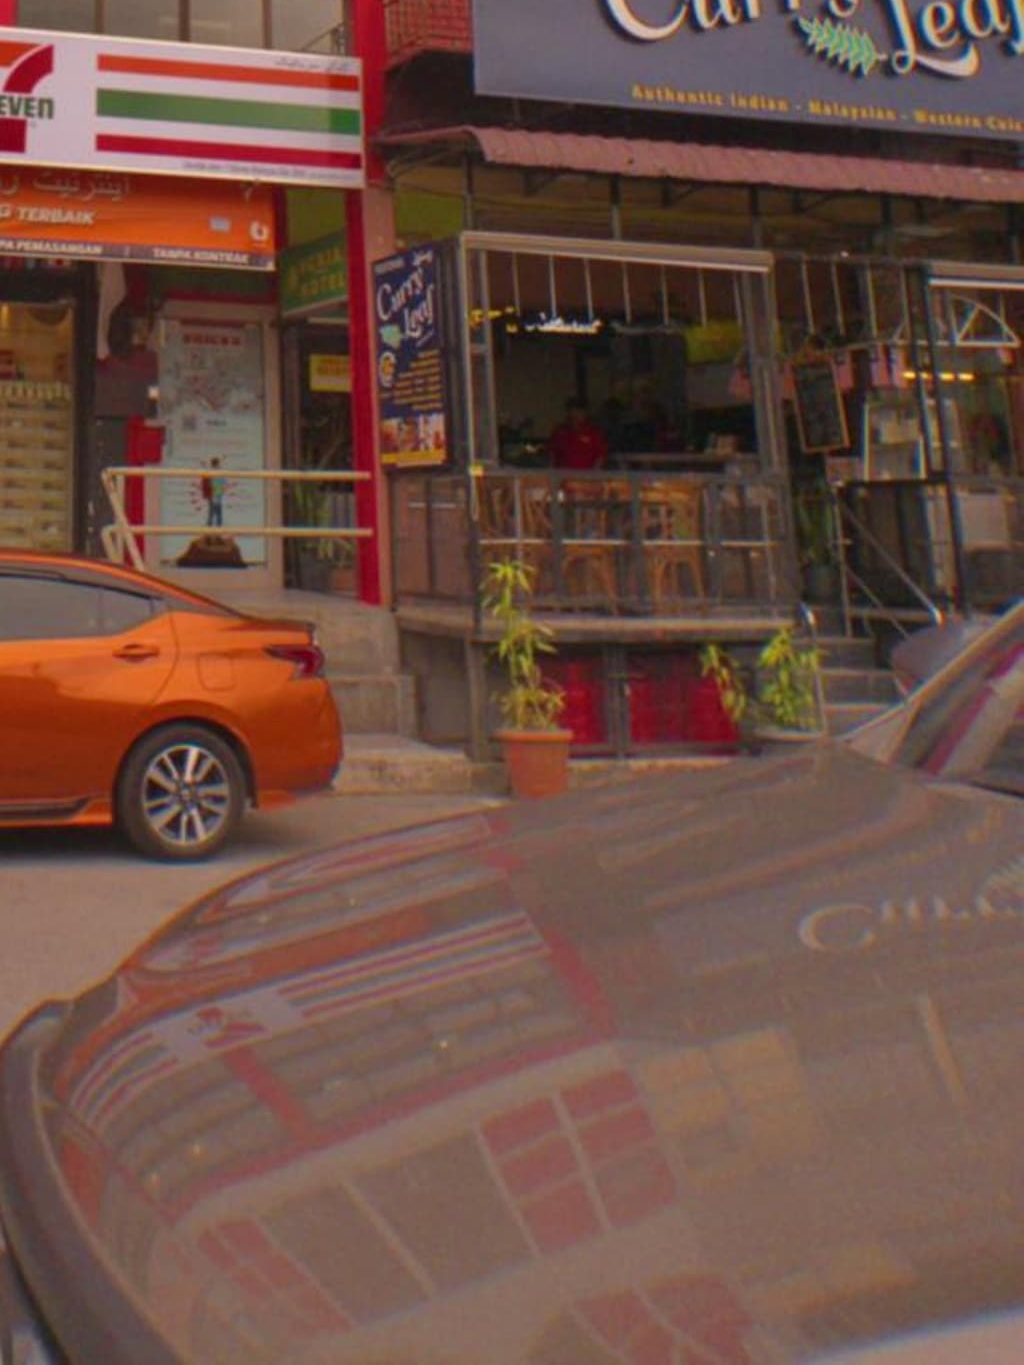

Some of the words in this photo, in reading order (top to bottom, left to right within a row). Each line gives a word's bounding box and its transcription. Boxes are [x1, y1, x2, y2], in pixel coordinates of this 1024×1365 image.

[631, 83, 724, 108] Authentic
[808, 97, 898, 123] Malaysian
[15, 205, 95, 225] TERBAIK
[376, 266, 424, 321] Curry
